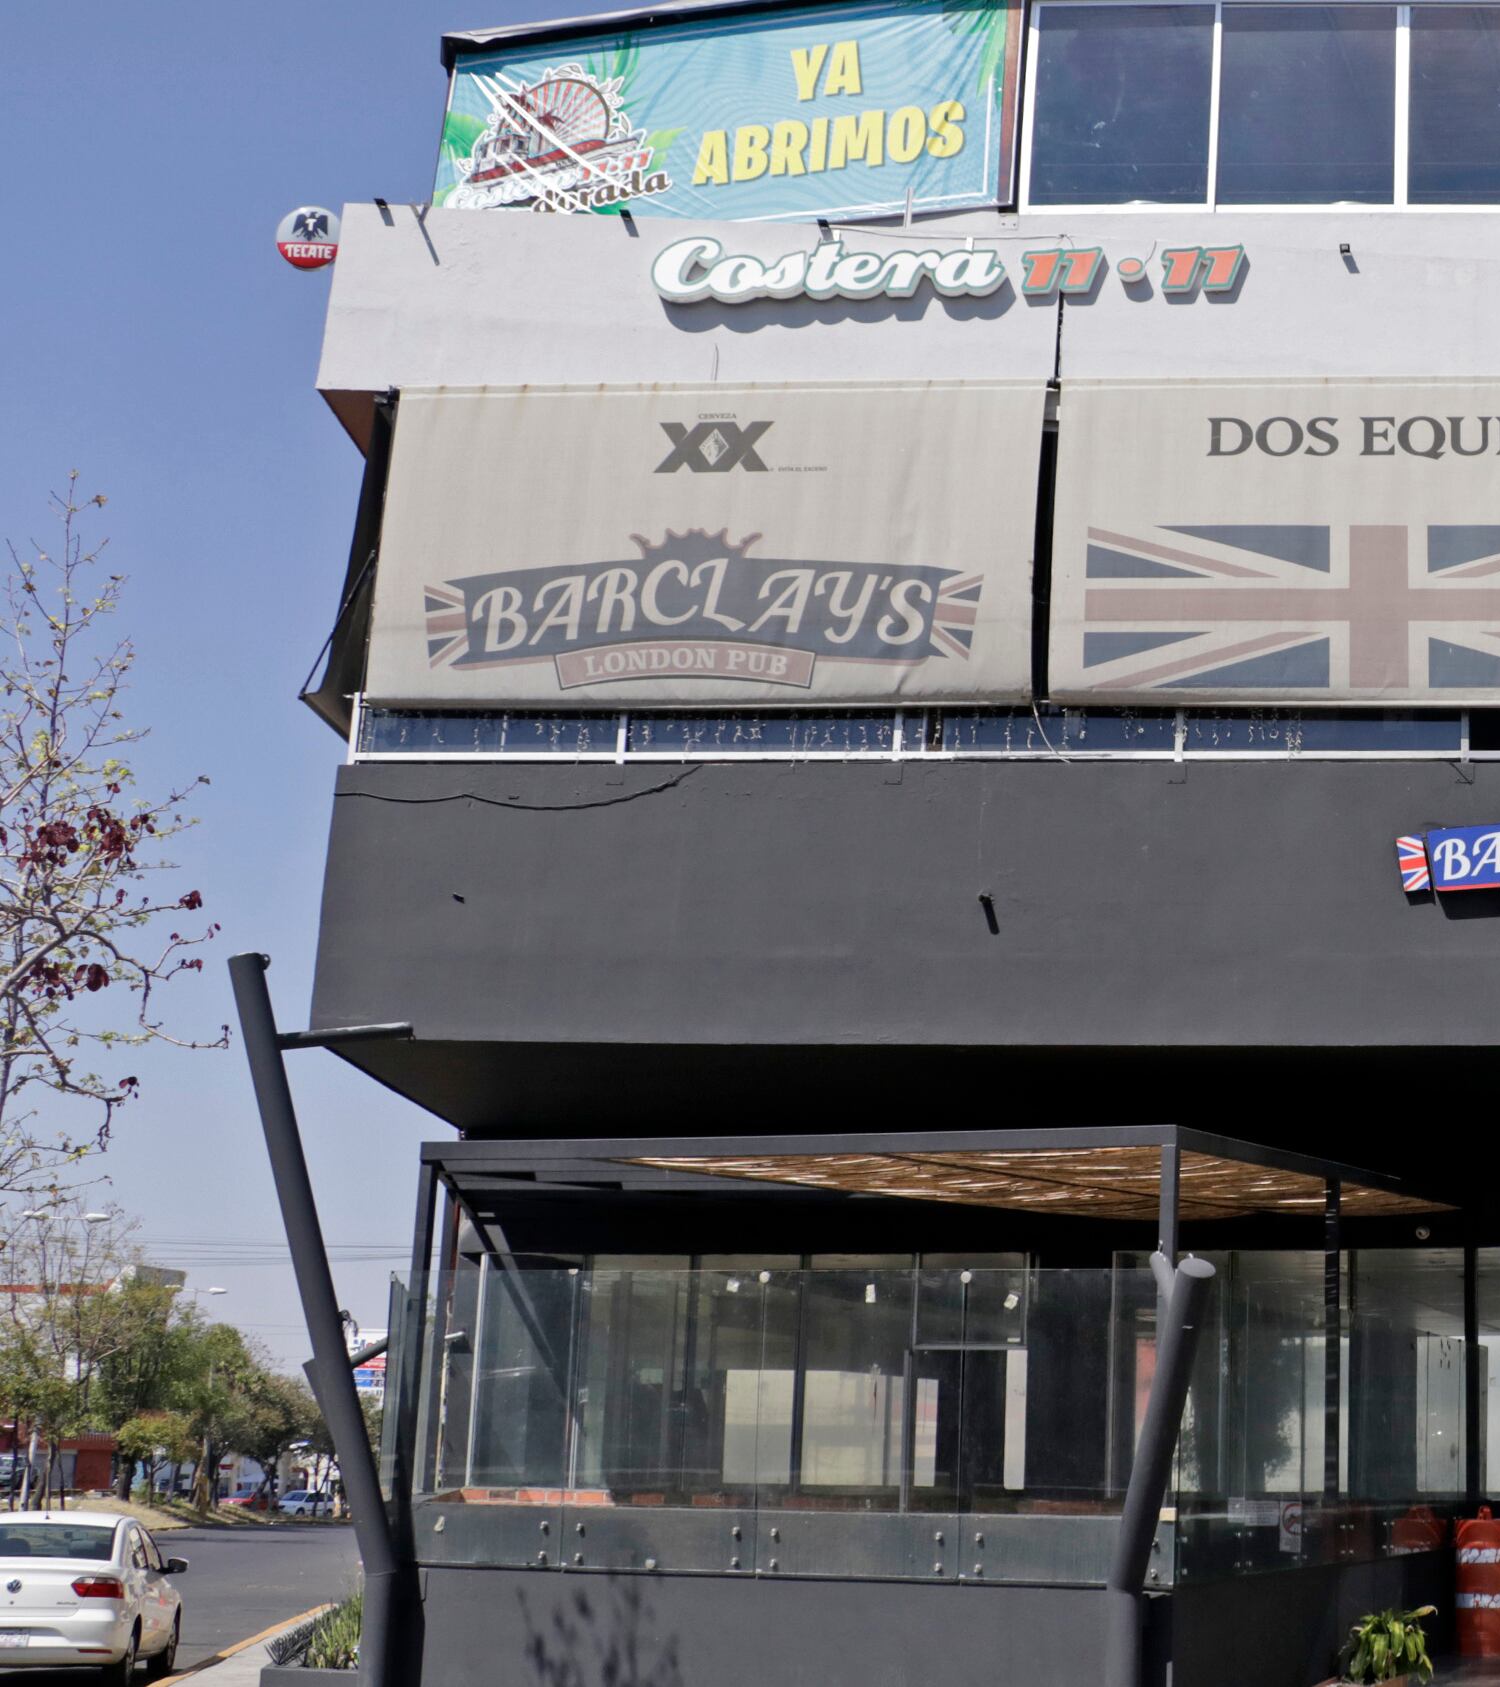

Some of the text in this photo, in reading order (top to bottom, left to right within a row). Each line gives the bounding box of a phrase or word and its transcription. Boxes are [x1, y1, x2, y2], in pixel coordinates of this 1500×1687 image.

[790, 39, 862, 100] YA
[691, 99, 966, 185] ABRIMOS
[284, 243, 334, 260] TECATE
[654, 239, 1004, 297] Costera
[698, 412, 737, 420] CERVEZA
[1206, 416, 1340, 457] DOS
[653, 421, 775, 473] XX
[471, 557, 932, 653] BARCLAY'S
[584, 646, 789, 678] LONDON PUB
